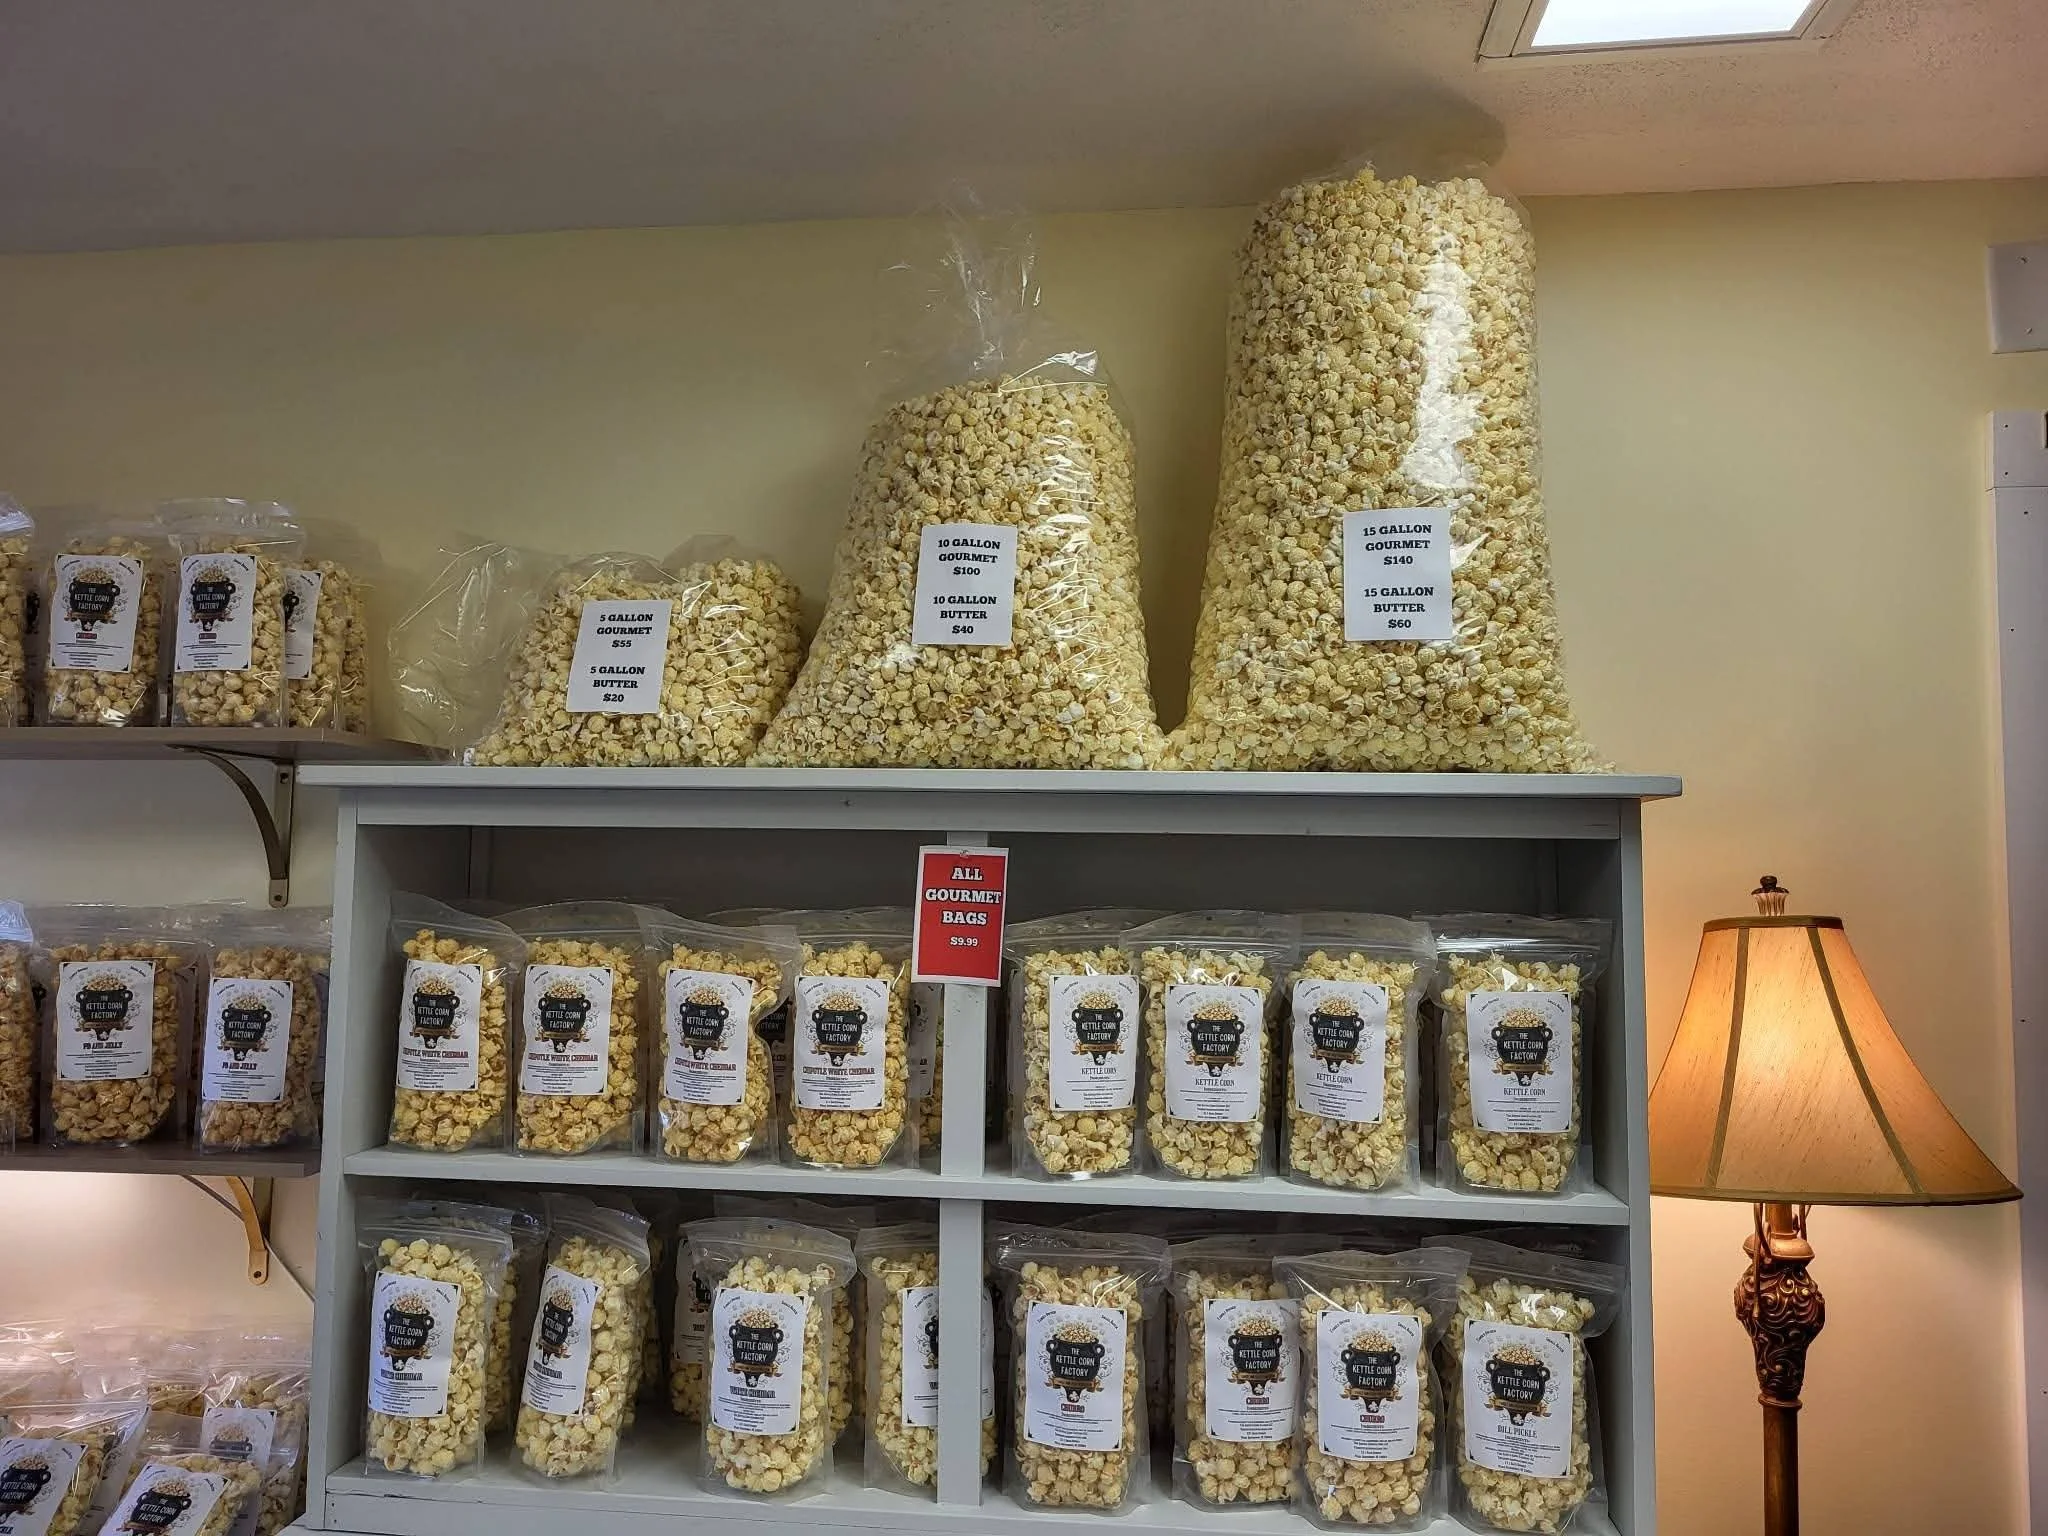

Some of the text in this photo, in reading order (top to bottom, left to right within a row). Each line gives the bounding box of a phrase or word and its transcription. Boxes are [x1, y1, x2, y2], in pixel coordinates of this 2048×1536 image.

[1363, 524, 1432, 536] 15 GALLON
[937, 538, 1001, 550] 10 GALLON
[1365, 540, 1431, 551] GOURMET
[938, 553, 998, 563] GOURMET
[1383, 555, 1413, 565] $140
[952, 566, 981, 575] $100
[1364, 587, 1434, 597] 15 GALLON
[933, 596, 997, 605] 10 GALLON
[1373, 603, 1425, 613] BUTTER
[600, 614, 653, 622] 5 GALLON
[940, 610, 987, 619] BUTTER
[1388, 618, 1412, 629] $60
[596, 627, 652, 635] GOURMET
[952, 625, 974, 634] $40
[611, 639, 632, 648] $55
[590, 666, 646, 675] 5 GALLON
[593, 679, 638, 688] BUTTER
[602, 693, 625, 702] $20
[951, 866, 984, 881] ALL
[925, 888, 1002, 904] GOURMET
[942, 910, 988, 926] BAGS
[950, 936, 978, 947] $9.99
[1095, 1013, 1103, 1021] THE
[821, 1023, 858, 1031] KETTLE CORN
[1081, 1021, 1116, 1030] KETTLE CORN
[825, 1033, 851, 1042] FACTORY
[1087, 1032, 1112, 1041] FACTORY
[1197, 1033, 1236, 1042] KETTLE CORN
[1317, 1027, 1354, 1039] KETTLE CORN
[1202, 1043, 1230, 1052] FACTORY
[1322, 1039, 1349, 1048] FACTORY
[1503, 1040, 1544, 1049] KETTLE CORN
[1510, 1052, 1538, 1061] FACTORY
[828, 1067, 848, 1075] WHITE
[1081, 1067, 1103, 1075] KETTLE
[1195, 1078, 1220, 1086] KETTLE
[1316, 1073, 1353, 1084] KETTLE CORN
[1503, 1088, 1546, 1096] KETTLE CORN
[389, 1324, 424, 1337] KETTLE CORN
[391, 1336, 416, 1346] FACTORY
[736, 1341, 774, 1351] KETTLE CORN
[740, 1352, 767, 1362] FACTORY
[1239, 1349, 1260, 1358] KETTLE
[1055, 1355, 1095, 1366] KETTLE CORN
[1245, 1360, 1272, 1369] FACTORY
[1060, 1368, 1089, 1377] FACTORY
[1352, 1365, 1392, 1375] KETTLE CORN
[1358, 1376, 1387, 1386] FACTORY
[1497, 1375, 1540, 1389] KETTLE CORN
[1503, 1390, 1534, 1400] FACTORY
[1513, 1427, 1538, 1439] PICKLE
